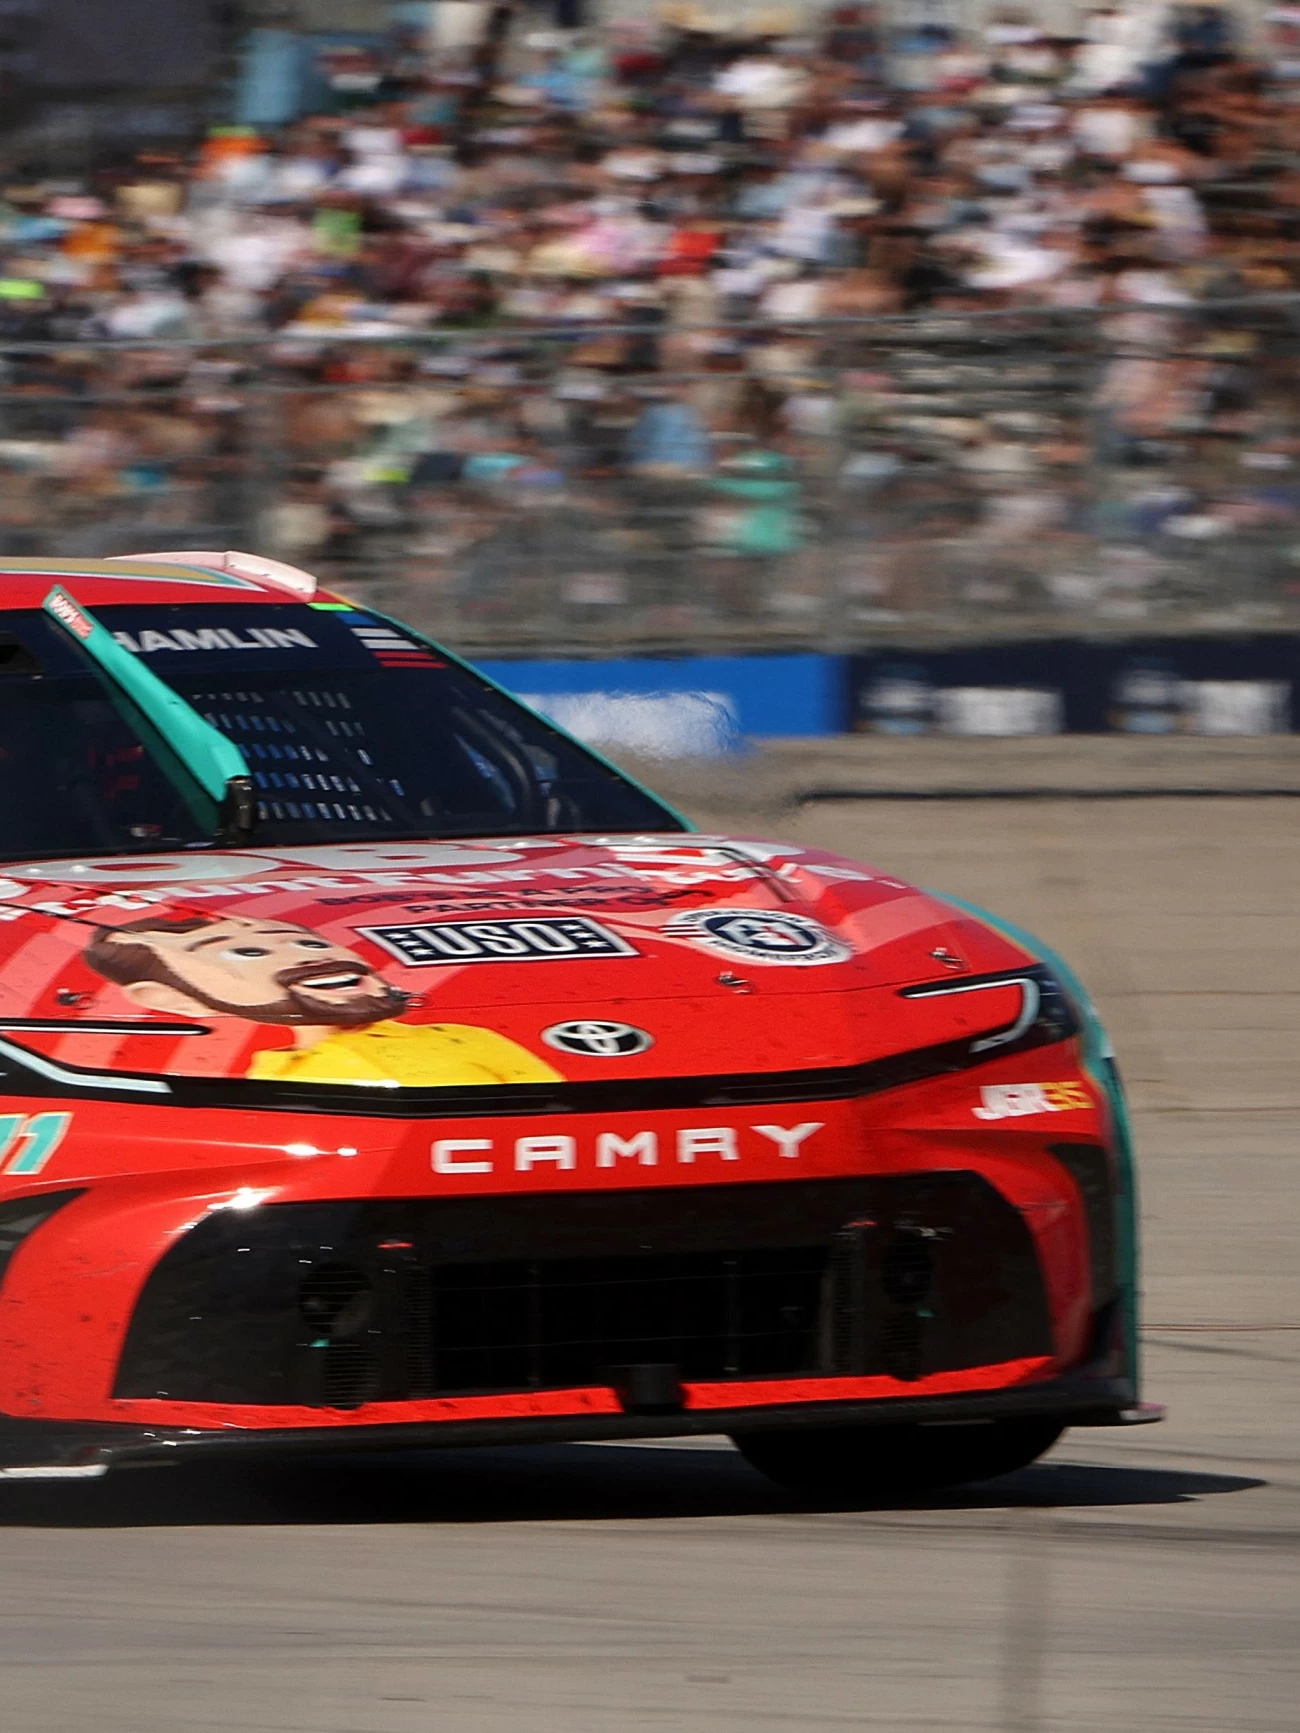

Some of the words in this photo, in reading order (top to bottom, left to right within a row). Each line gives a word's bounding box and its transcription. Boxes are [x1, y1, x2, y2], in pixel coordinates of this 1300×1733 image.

[112, 627, 319, 652] HAMLIN
[414, 922, 570, 955] USO
[431, 1122, 825, 1174] CAMRY
